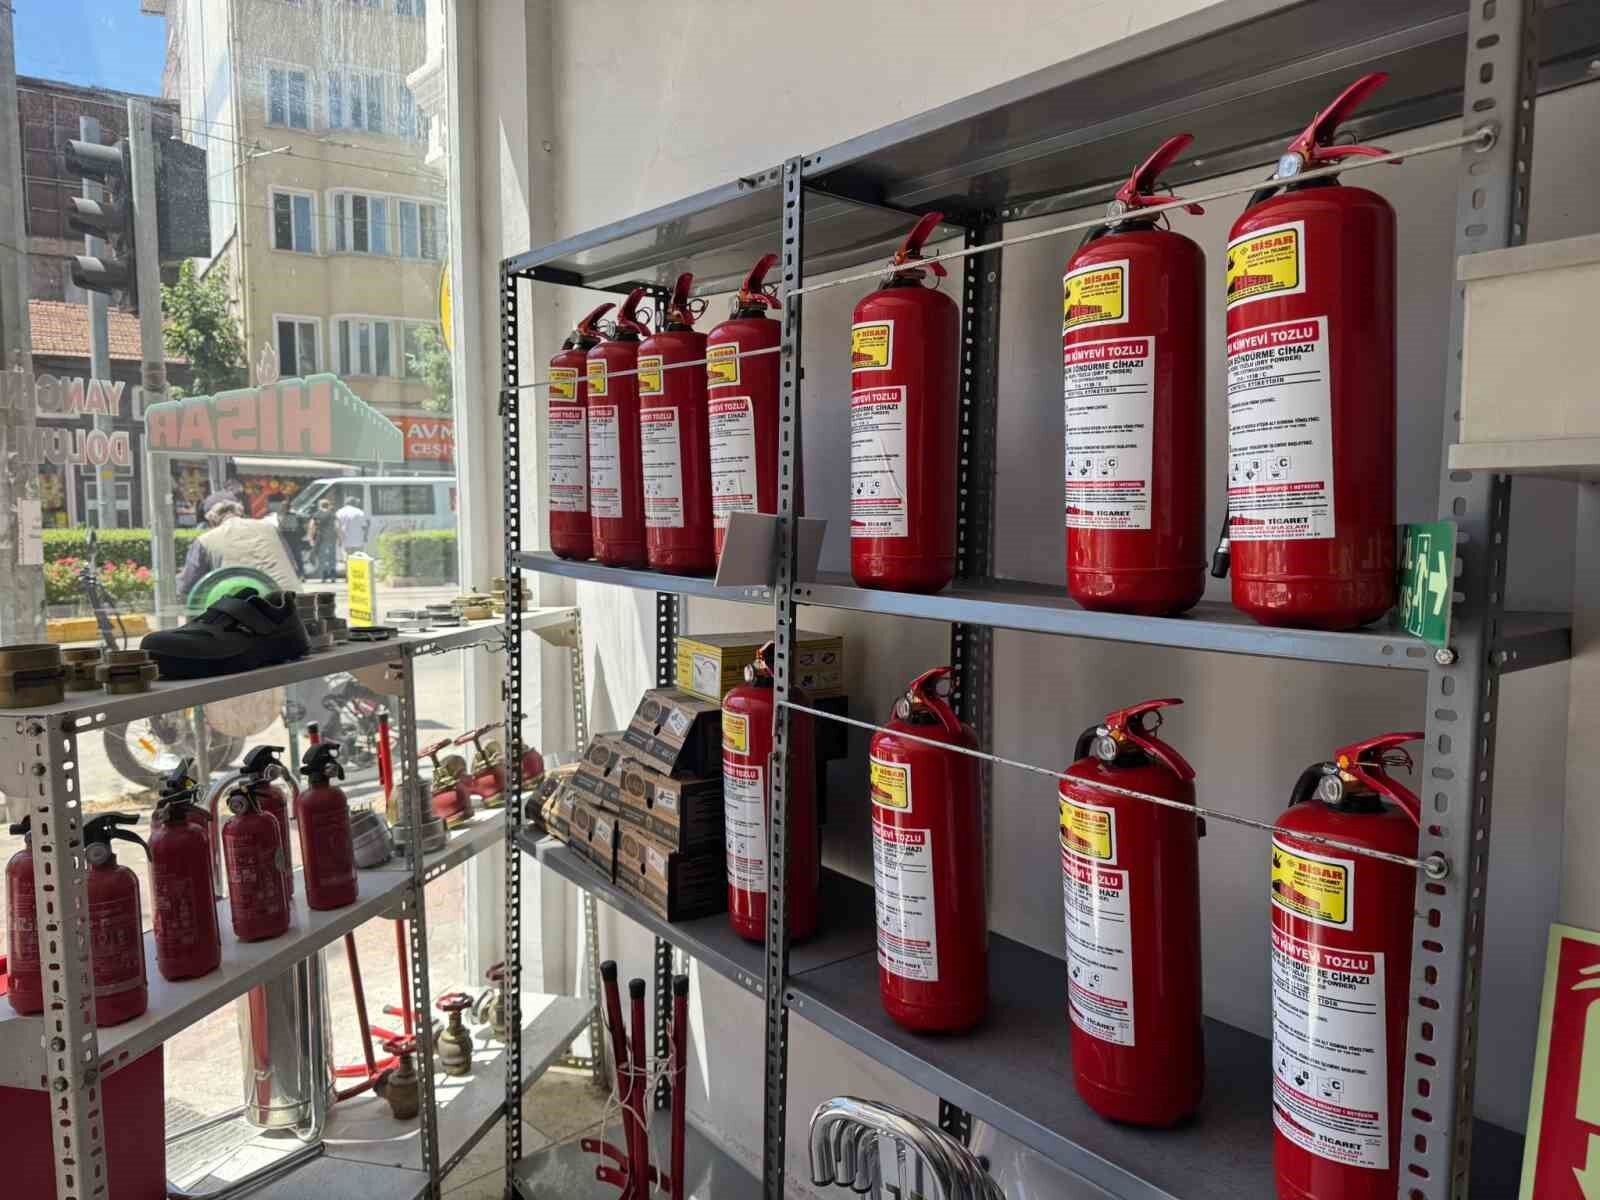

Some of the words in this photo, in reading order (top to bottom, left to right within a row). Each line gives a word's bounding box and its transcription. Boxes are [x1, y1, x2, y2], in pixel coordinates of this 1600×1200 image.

[1271, 327, 1313, 343] TOZLU
[1109, 344, 1144, 357] TOZLU
[1278, 344, 1315, 357] CİHAZI
[1112, 359, 1144, 369] CİHAZI
[872, 391, 898, 401] TOZLU
[1108, 458, 1116, 467] C
[1280, 458, 1288, 467] C
[1268, 517, 1308, 525] TİCARET
[1324, 953, 1369, 971] TOZLU
[1331, 970, 1370, 985] CİHAZI
[1332, 1080, 1341, 1090] C
[1319, 1132, 1362, 1151] TİCARET
